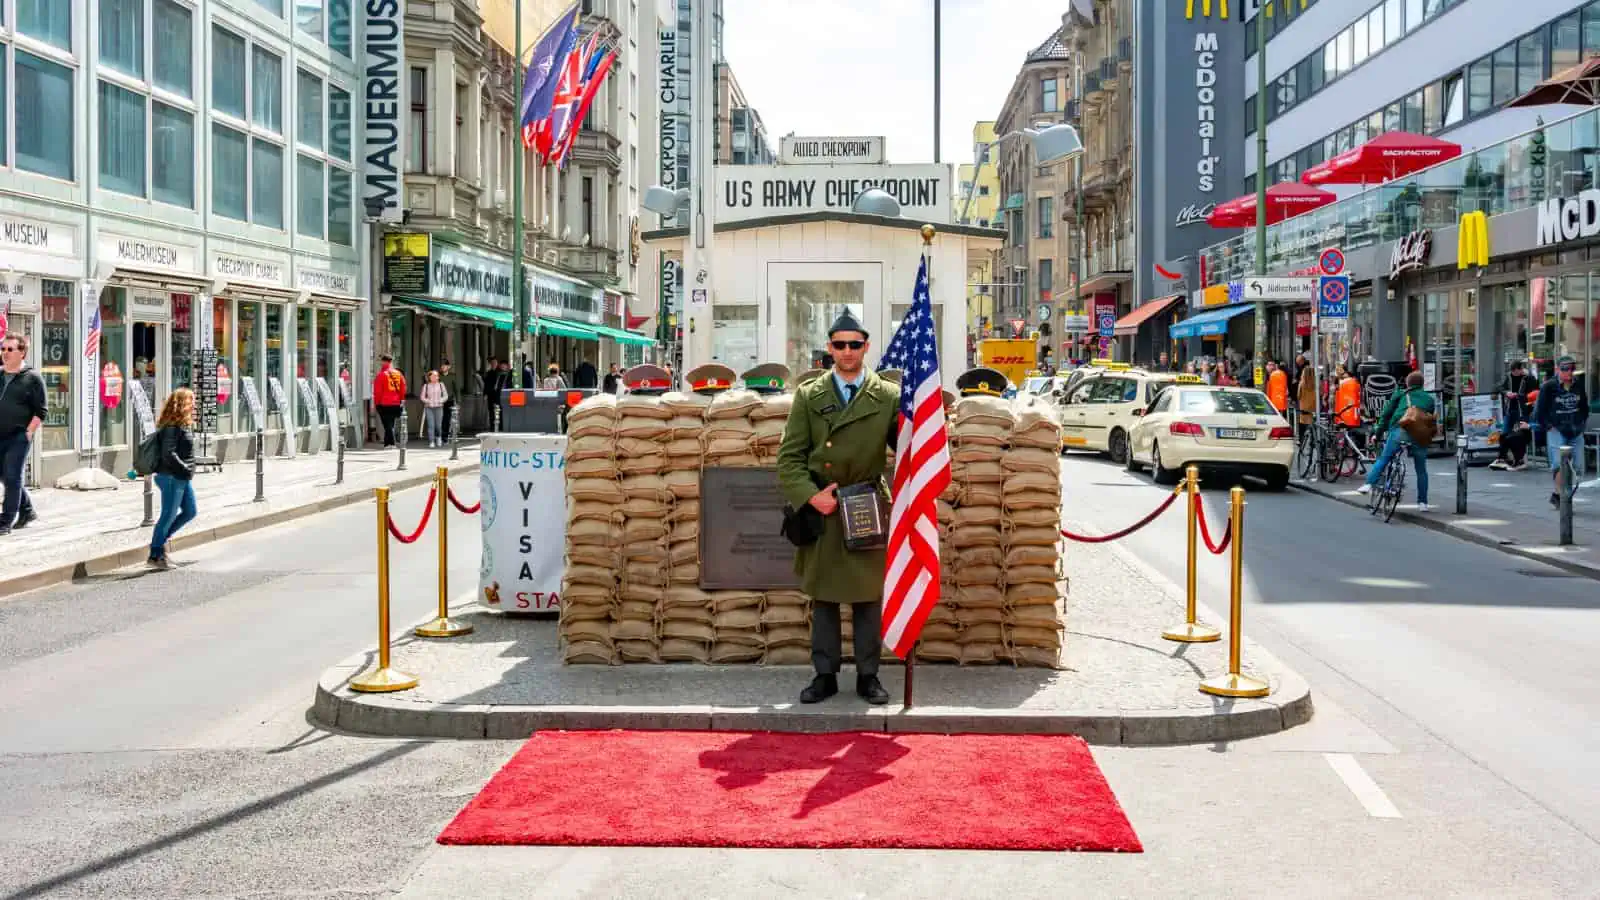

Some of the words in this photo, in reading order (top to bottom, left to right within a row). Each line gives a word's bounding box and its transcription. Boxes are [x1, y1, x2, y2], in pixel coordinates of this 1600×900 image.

[661, 31, 675, 104] CHARLIE
[1194, 32, 1219, 192] McDonald's
[793, 142, 819, 157] ALLIED
[822, 141, 872, 157] CHECKPOINT
[725, 180, 753, 207] US
[763, 180, 816, 207] ARMY
[4, 221, 48, 248] MUSEUM
[118, 240, 177, 265] MAUERMUSEUM
[217, 257, 254, 277] CHECKPOINT
[433, 261, 483, 291] CHECKPOINT
[484, 271, 511, 297] CHARLIE
[1321, 304, 1346, 314] TAXI
[518, 481, 533, 581] VISA
